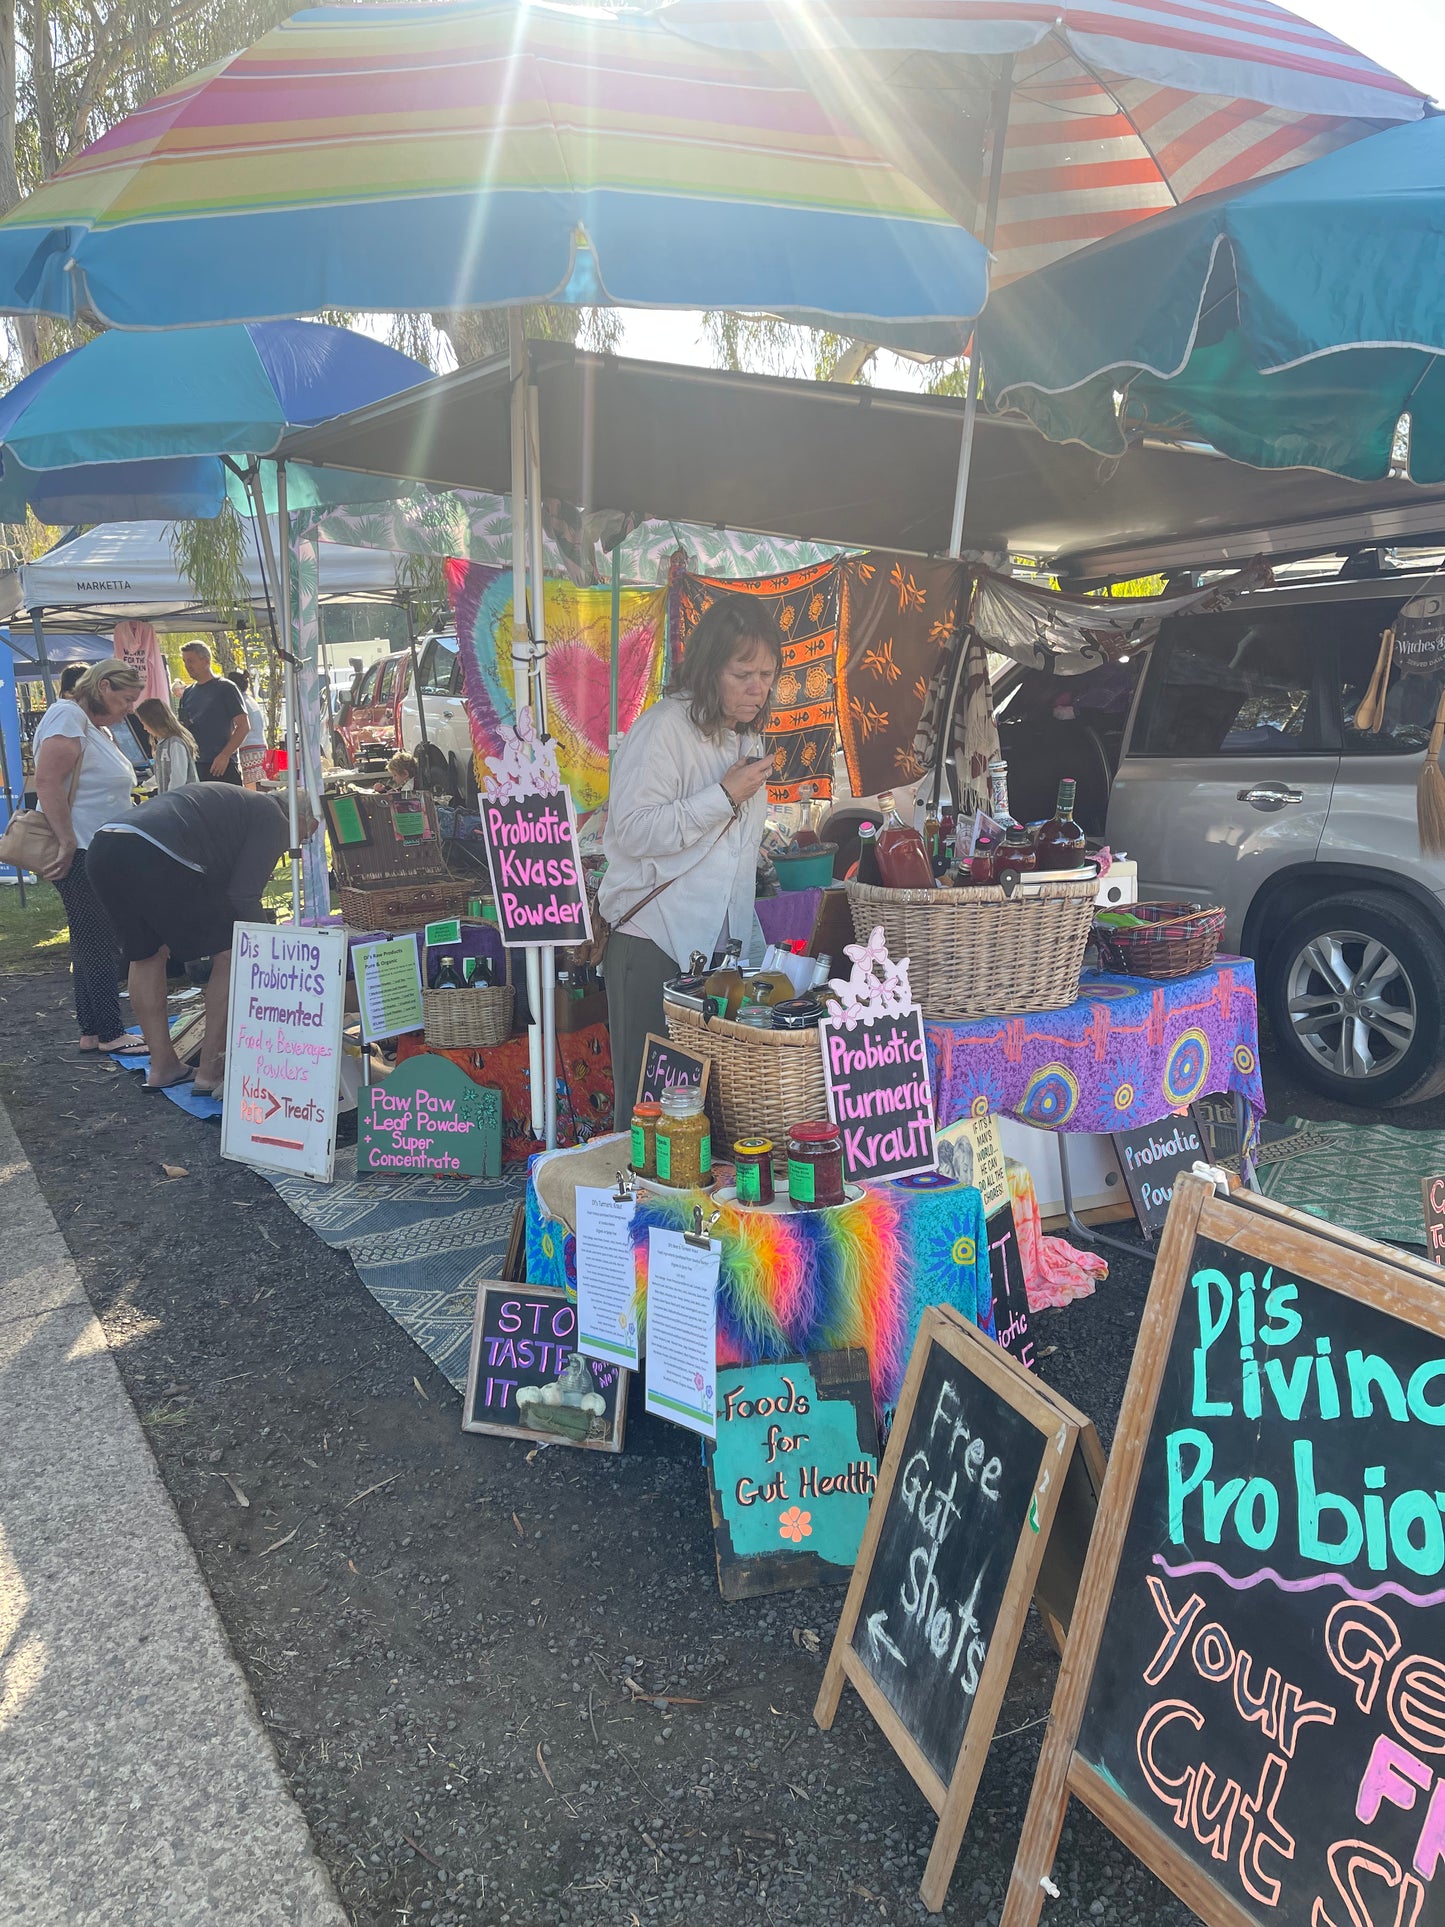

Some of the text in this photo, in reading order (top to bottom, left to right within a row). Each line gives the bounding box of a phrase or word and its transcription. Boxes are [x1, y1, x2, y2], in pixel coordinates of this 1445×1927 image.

[77, 581, 131, 591] MARKETTA
[1395, 639, 1435, 654] Witches
[488, 807, 572, 847] Probiotic
[499, 849, 578, 887] Kvass
[501, 892, 583, 929] Powder
[271, 937, 320, 970] Living
[251, 963, 325, 995] Probiotics
[249, 996, 324, 1027] Fermented
[277, 1027, 332, 1065] Beverages
[829, 1027, 924, 1076] Probiotic
[242, 1075, 267, 1099] Kids
[256, 1055, 310, 1082] Powders
[240, 1100, 264, 1125] Pets
[281, 1096, 325, 1123] Treats
[371, 1087, 455, 1113] Paw Paw
[831, 1072, 932, 1121] Turmeric
[417, 1112, 475, 1133] Powder
[844, 1110, 933, 1172] Kraut
[972, 1121, 978, 1134] IF
[369, 1148, 460, 1169] Concentrate
[392, 1131, 434, 1156] Super
[1125, 1128, 1200, 1171] Probiotic
[980, 1156, 998, 1176] HE CAN
[987, 1173, 996, 1187] ALL
[995, 1167, 1004, 1181] THE
[1192, 1266, 1302, 1348] Di's
[484, 1336, 573, 1377] TASTE
[485, 1377, 518, 1408] IT
[723, 1376, 810, 1422] Foods
[761, 1424, 810, 1464] for
[929, 1379, 1003, 1501] Free
[735, 1461, 878, 1507] Gut Health
[901, 1449, 962, 1545] Gut
[1166, 1428, 1445, 1577] Probio
[899, 1539, 991, 1696] Shots
[1143, 1574, 1337, 1759] Your
[1136, 1698, 1296, 1907] Gut
